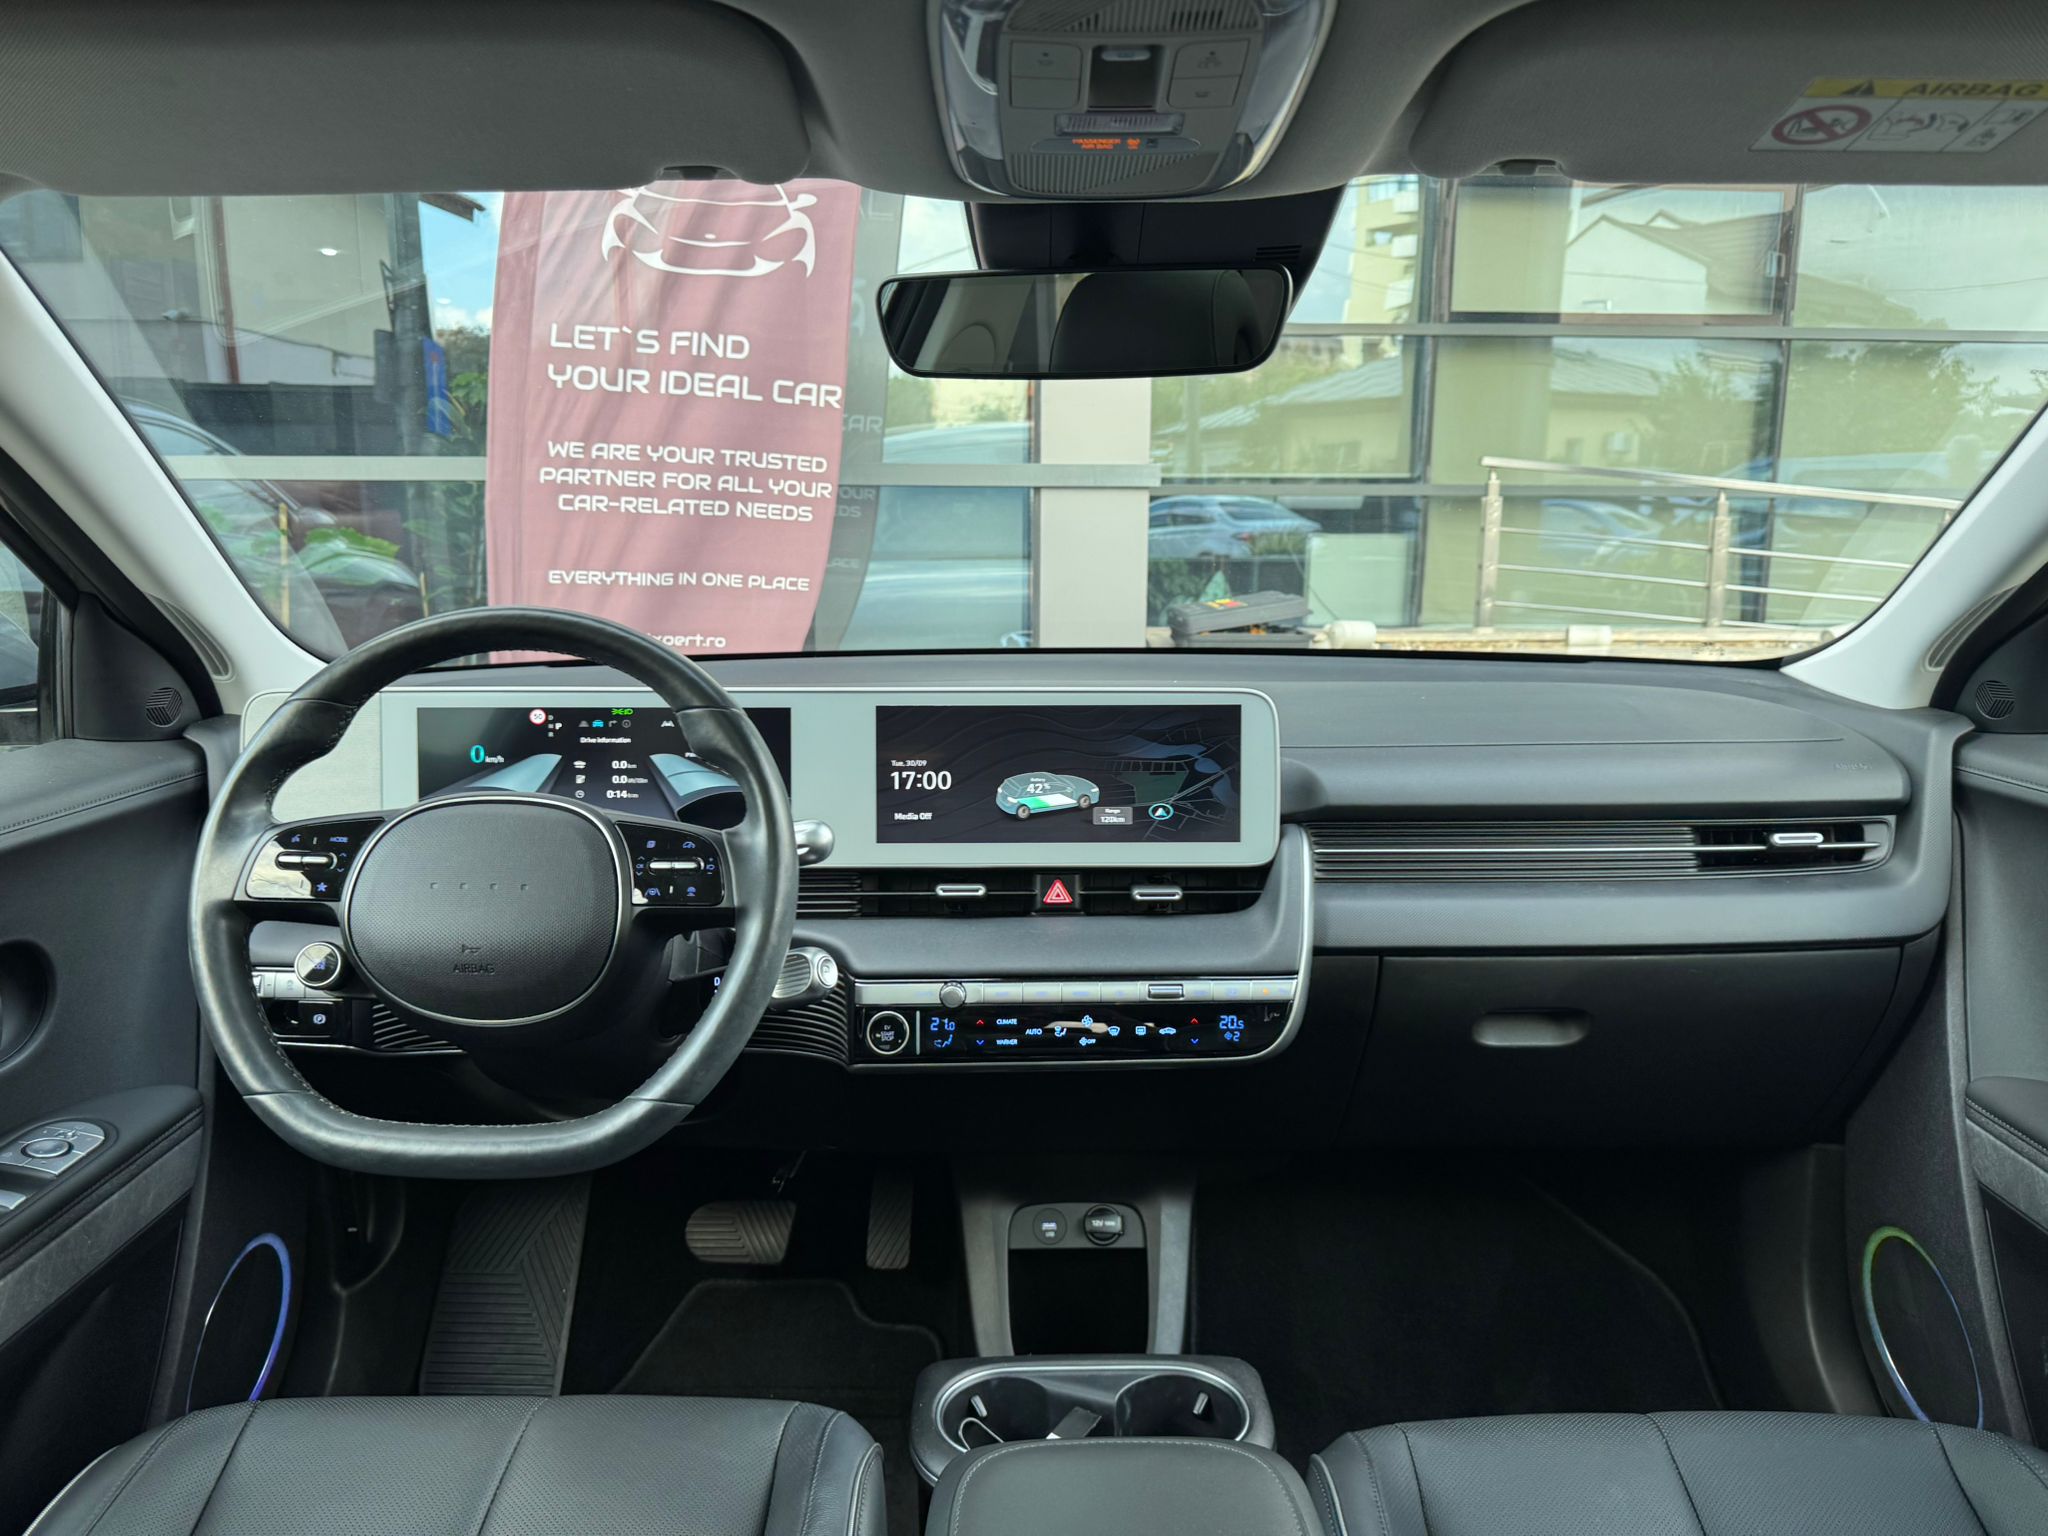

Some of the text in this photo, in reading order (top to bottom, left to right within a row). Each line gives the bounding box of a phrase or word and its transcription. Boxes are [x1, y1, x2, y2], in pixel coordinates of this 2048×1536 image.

[1902, 81, 2045, 98] AIRBAG
[669, 330, 750, 360] FIND
[547, 363, 843, 409] YOUR IDEAL CAR
[548, 440, 828, 473] WE ARE YOUR TRUSTED
[539, 467, 833, 499] PARTNER FOR ALL YOUR
[558, 493, 814, 522] CAR-RELATED NEEDS
[548, 570, 811, 591] EVERYTHING IN ONE PLACE
[470, 744, 485, 764] 0
[611, 760, 628, 769] 0.0
[612, 775, 628, 784] 0.0
[890, 770, 952, 790] 17:00
[606, 790, 628, 799] 0:14
[894, 812, 933, 821] Media Off
[453, 963, 496, 975] AIRBAG
[1025, 1028, 1043, 1036] AUTO
